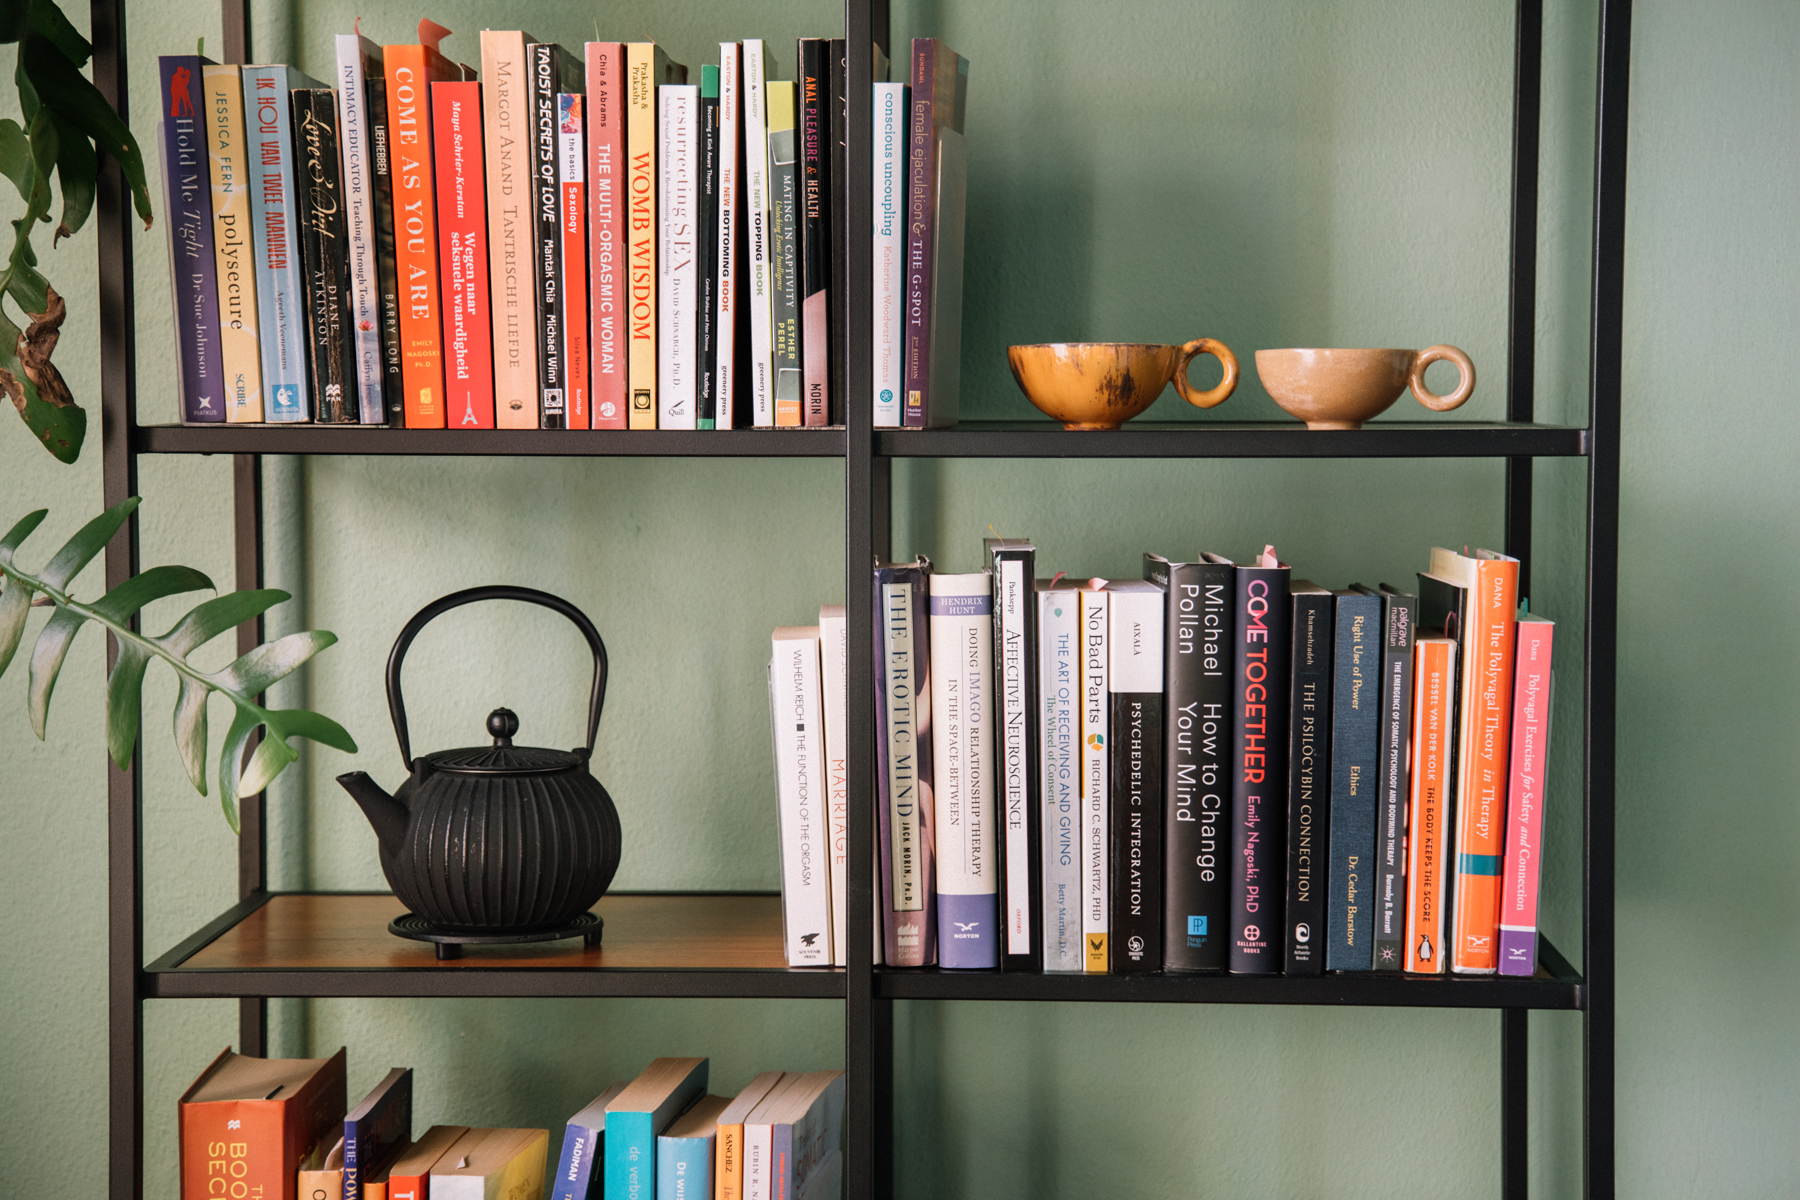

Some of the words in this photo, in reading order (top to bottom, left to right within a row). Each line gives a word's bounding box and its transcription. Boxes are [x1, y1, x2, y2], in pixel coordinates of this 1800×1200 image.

[256, 78, 276, 90] IK
[344, 65, 357, 126] INTIMACY
[632, 66, 640, 105] Prakasha
[640, 62, 649, 101] Prakasha
[805, 76, 817, 104] ANAL
[215, 91, 230, 150] JESSICA
[257, 97, 279, 133] HOU
[395, 67, 418, 145] COME
[176, 118, 197, 166] Hold
[806, 108, 818, 162] PLEASURE
[884, 92, 896, 158] conscious
[260, 141, 281, 166] VAN
[348, 129, 362, 194] EDUCATOR
[568, 154, 576, 180] basics
[806, 166, 817, 175] &
[180, 174, 199, 202] Me
[220, 157, 233, 193] FERN
[262, 172, 284, 204] TWEE
[401, 155, 421, 189] AS
[723, 169, 731, 183] THE
[632, 151, 650, 231] WOMB
[807, 180, 819, 218] HEALTH
[881, 161, 897, 237] uncoupling
[353, 199, 363, 242] Teaching
[405, 199, 425, 254] YOU
[568, 187, 578, 233] Sexology
[178, 209, 204, 258] Tight
[265, 211, 288, 269] MANNEN
[722, 209, 730, 277] BOTTOMING
[219, 213, 243, 330] polysecure
[355, 243, 366, 285] Through
[451, 231, 465, 291] seksuele
[463, 231, 476, 279] Wegen
[191, 273, 204, 290] Dr
[409, 263, 429, 319] ARE
[466, 281, 476, 315] naar
[632, 239, 651, 341] WISDOM
[721, 280, 729, 312] BOOK
[193, 294, 205, 320] Sue
[314, 270, 329, 346] ATKINSON
[328, 285, 340, 330] DIANE
[359, 287, 369, 317] Touch
[384, 294, 396, 333] BARRY
[195, 323, 208, 378] Johnson
[453, 293, 469, 380] waardigheid
[546, 314, 558, 356] Michael
[777, 322, 786, 356] PEREL
[787, 318, 796, 360] ESTHER
[387, 341, 399, 374] LONG
[547, 356, 558, 383] Winn
[235, 373, 247, 408] SCRIBE
[719, 365, 727, 396] greenery
[668, 407, 685, 417] Quill
[719, 397, 727, 416] press
[810, 383, 822, 415] MORIN
[949, 606, 975, 614] HUNT
[1008, 581, 1016, 614] Panksepp
[1246, 579, 1269, 643] COME
[1493, 577, 1503, 609] DANA
[890, 588, 908, 639] THE
[1088, 606, 1103, 631] No
[1178, 584, 1199, 654] Pollan
[1203, 584, 1224, 676] Michael
[1352, 615, 1364, 644] Right
[1390, 607, 1398, 647] macmillan
[1397, 607, 1409, 647] palgrave
[968, 628, 978, 668] DOING
[1058, 633, 1069, 657] THE
[1088, 635, 1103, 670] Bad
[1133, 621, 1142, 656] AIXALÀ
[1490, 622, 1504, 648] The
[1530, 639, 1540, 661] Dana
[793, 649, 804, 691] WILHELM
[1006, 629, 1021, 708] AFFECTIVE
[1058, 660, 1070, 684] ART
[1352, 666, 1363, 678] of
[1353, 645, 1363, 665] Use
[1394, 661, 1402, 673] THE
[892, 651, 912, 743] EROTIC
[969, 672, 981, 723] IMAGO
[1058, 687, 1070, 706] OF
[1088, 674, 1103, 724] Parts
[1352, 678, 1363, 710] Power
[1392, 674, 1402, 710] EMERGENCE
[1430, 672, 1440, 705] BESSEL
[1483, 652, 1503, 711] Polyvagal
[794, 694, 805, 721] REICH
[1047, 695, 1056, 714] The
[1243, 647, 1268, 784] TOGETHER
[1392, 711, 1400, 720] OF
[1429, 707, 1438, 730] VAN
[797, 733, 806, 751] THE
[1047, 715, 1057, 749] Wheel
[1058, 709, 1071, 779] RECEIVING
[1177, 702, 1198, 755] Your
[1202, 703, 1222, 756] How
[1391, 721, 1400, 748] SOMATIC
[1428, 733, 1438, 753] DER
[1480, 714, 1499, 761] Theory
[1007, 711, 1022, 830] NEUROSCIENCE
[1048, 751, 1057, 762] of
[1130, 702, 1142, 806] PSYCHEDELIC
[1389, 750, 1399, 791] PSYCHOLOGY
[1427, 754, 1437, 781] KOLK
[797, 754, 808, 806] FUNCTION
[894, 754, 913, 817] MIND
[970, 727, 981, 818] RELATIONSHIP
[1048, 763, 1056, 805] Consent
[1201, 763, 1219, 786] to
[1350, 766, 1361, 796] Ethics
[1484, 769, 1495, 782] in
[1059, 783, 1071, 813] AND
[1176, 764, 1197, 822] Mind
[1388, 792, 1397, 803] AND
[1426, 786, 1435, 804] THE
[799, 808, 809, 821] OF
[1244, 795, 1261, 829] Emily
[1387, 804, 1397, 839] BODYMIND
[1426, 808, 1434, 835] BODY
[1476, 786, 1495, 839] Therapy
[800, 824, 810, 840] THE
[971, 821, 982, 877] THERAPY
[1060, 816, 1071, 866] GIVING
[1196, 794, 1221, 882] Change
[801, 842, 811, 886] ORGASM
[1130, 812, 1141, 916] INTEGRATION
[1243, 831, 1260, 882] Nagoski,
[1386, 840, 1396, 867] THERAPY
[1425, 838, 1433, 867] KEEPS
[1424, 869, 1432, 888] THE
[1246, 885, 1259, 913] PhD
[1423, 891, 1431, 922] SCORE
[1236, 940, 1267, 948] BALLANTINE
[567, 1137, 584, 1182] FADIMAN
